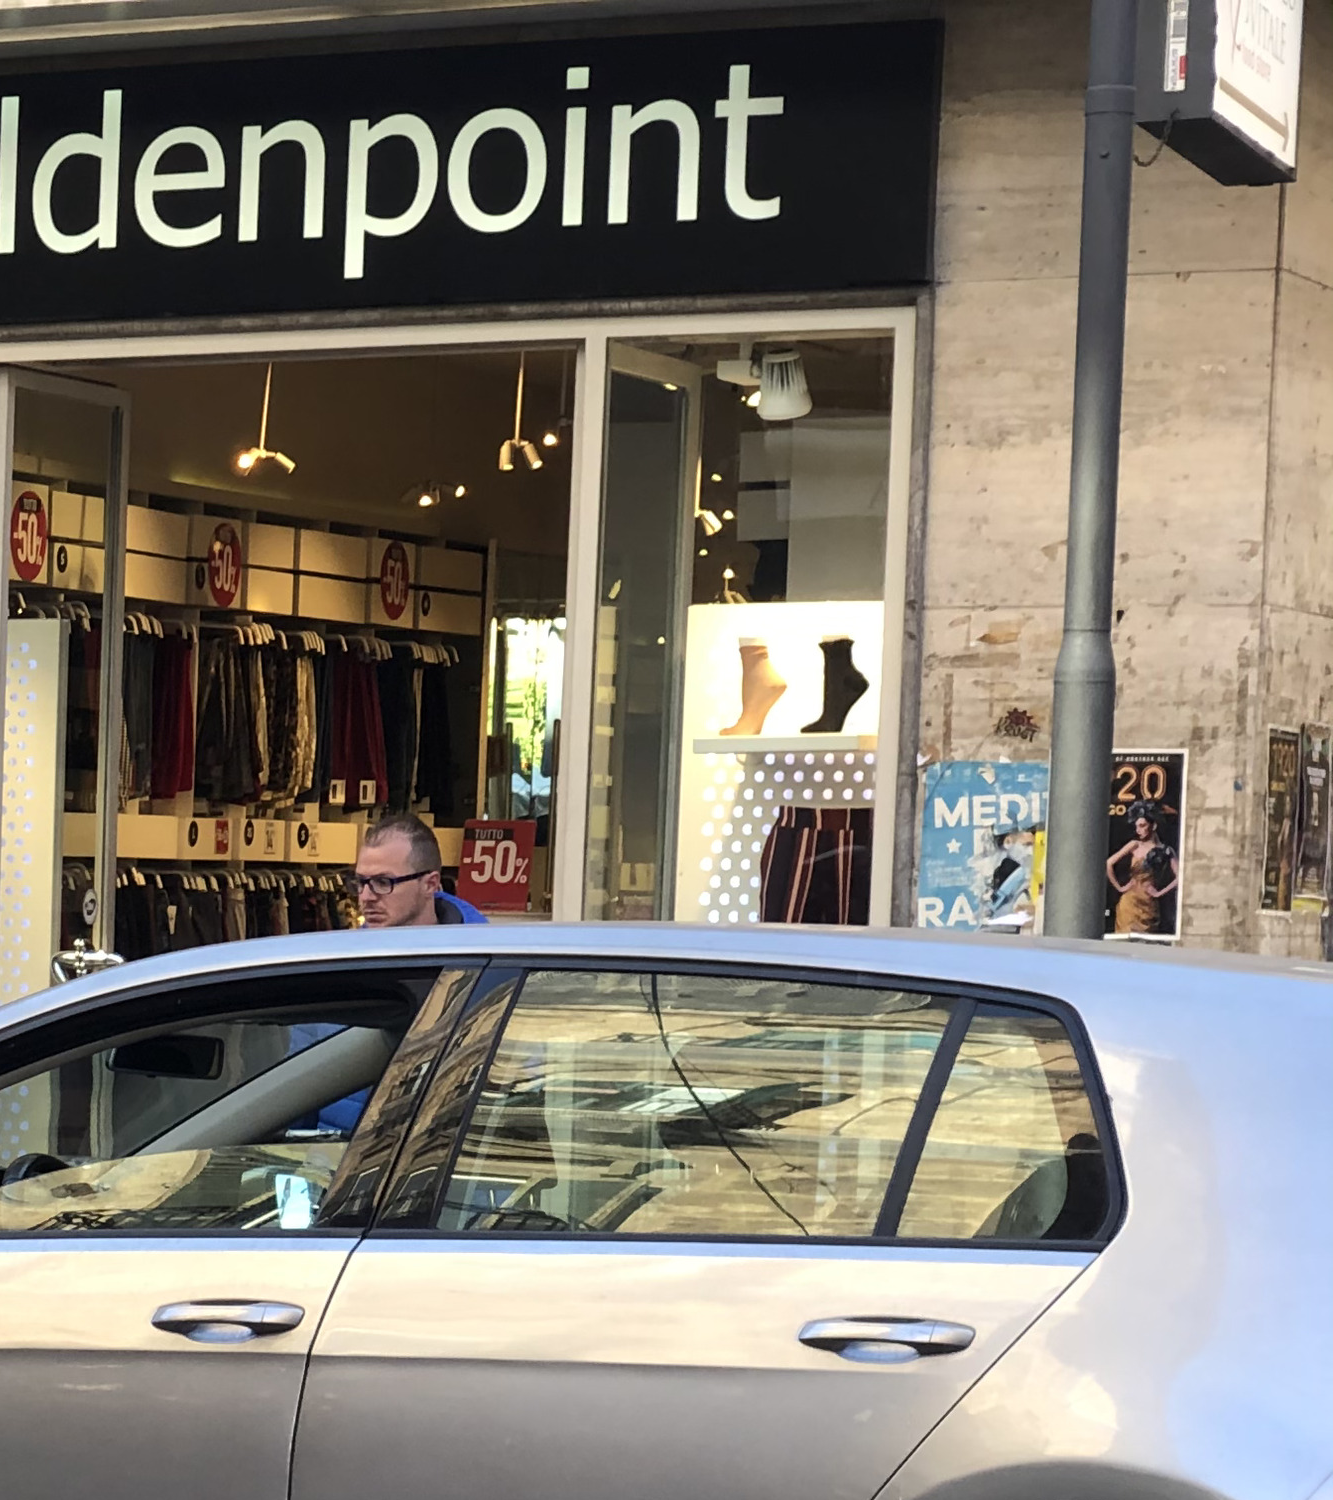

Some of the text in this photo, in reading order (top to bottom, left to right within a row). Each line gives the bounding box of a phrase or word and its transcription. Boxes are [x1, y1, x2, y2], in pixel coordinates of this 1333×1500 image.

[1112, 764, 1167, 802] 20
[934, 787, 1050, 830] MEDI
[474, 828, 504, 839] TUTTO
[462, 840, 529, 884] -50%
